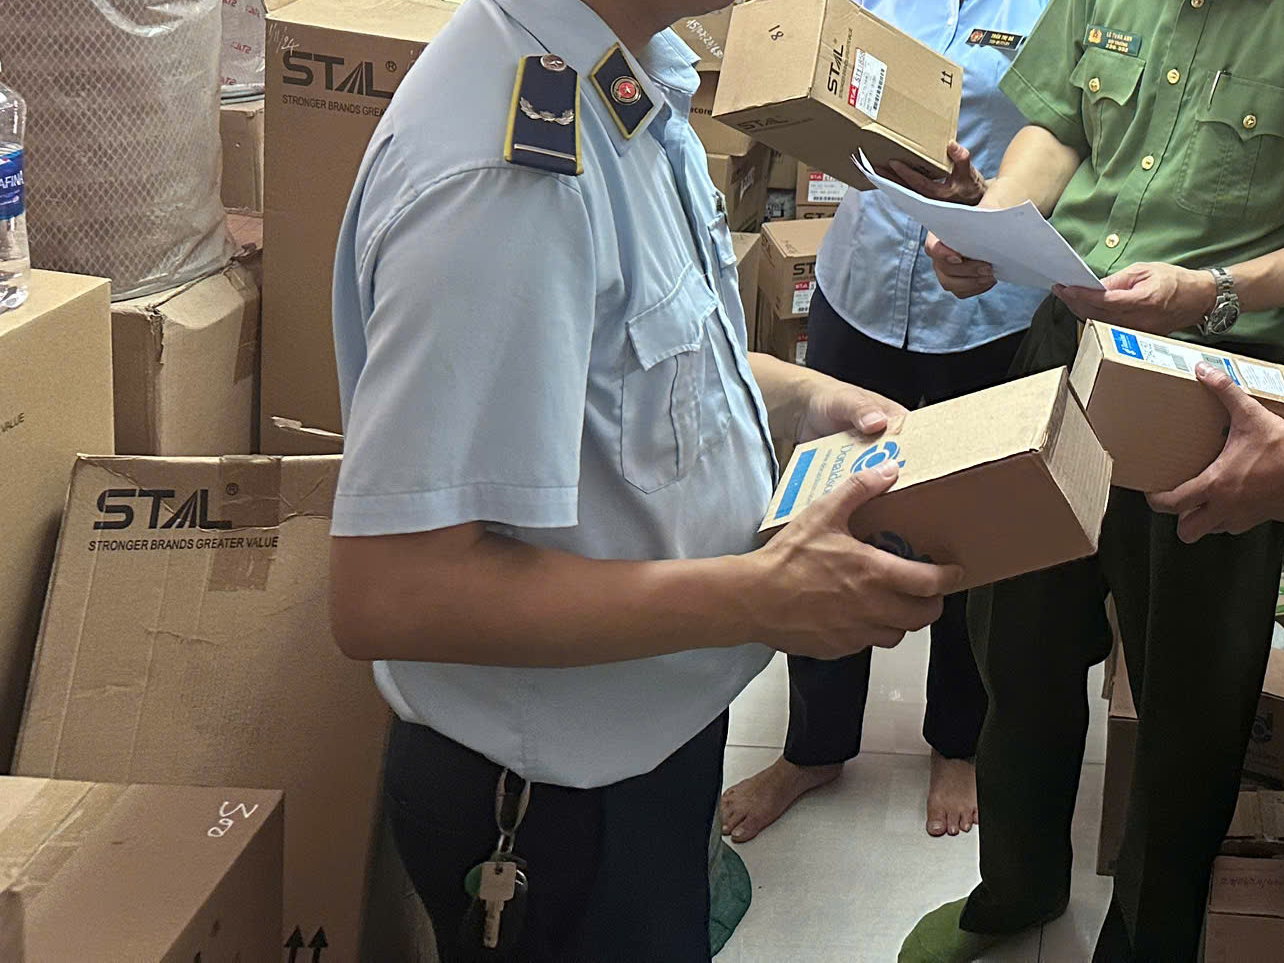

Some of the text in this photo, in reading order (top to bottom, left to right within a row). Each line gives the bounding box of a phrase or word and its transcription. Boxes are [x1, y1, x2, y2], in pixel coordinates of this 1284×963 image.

[768, 24, 785, 42] 18
[282, 50, 394, 100] STAL
[827, 44, 845, 96] STAL
[282, 94, 387, 118] STRONGER BRANDS GREA
[0, 169, 25, 189] AFINA
[793, 262, 816, 276] ST
[93, 488, 233, 530] STAL
[88, 536, 279, 552] STRONGER BRANDS GREATER VALUE
